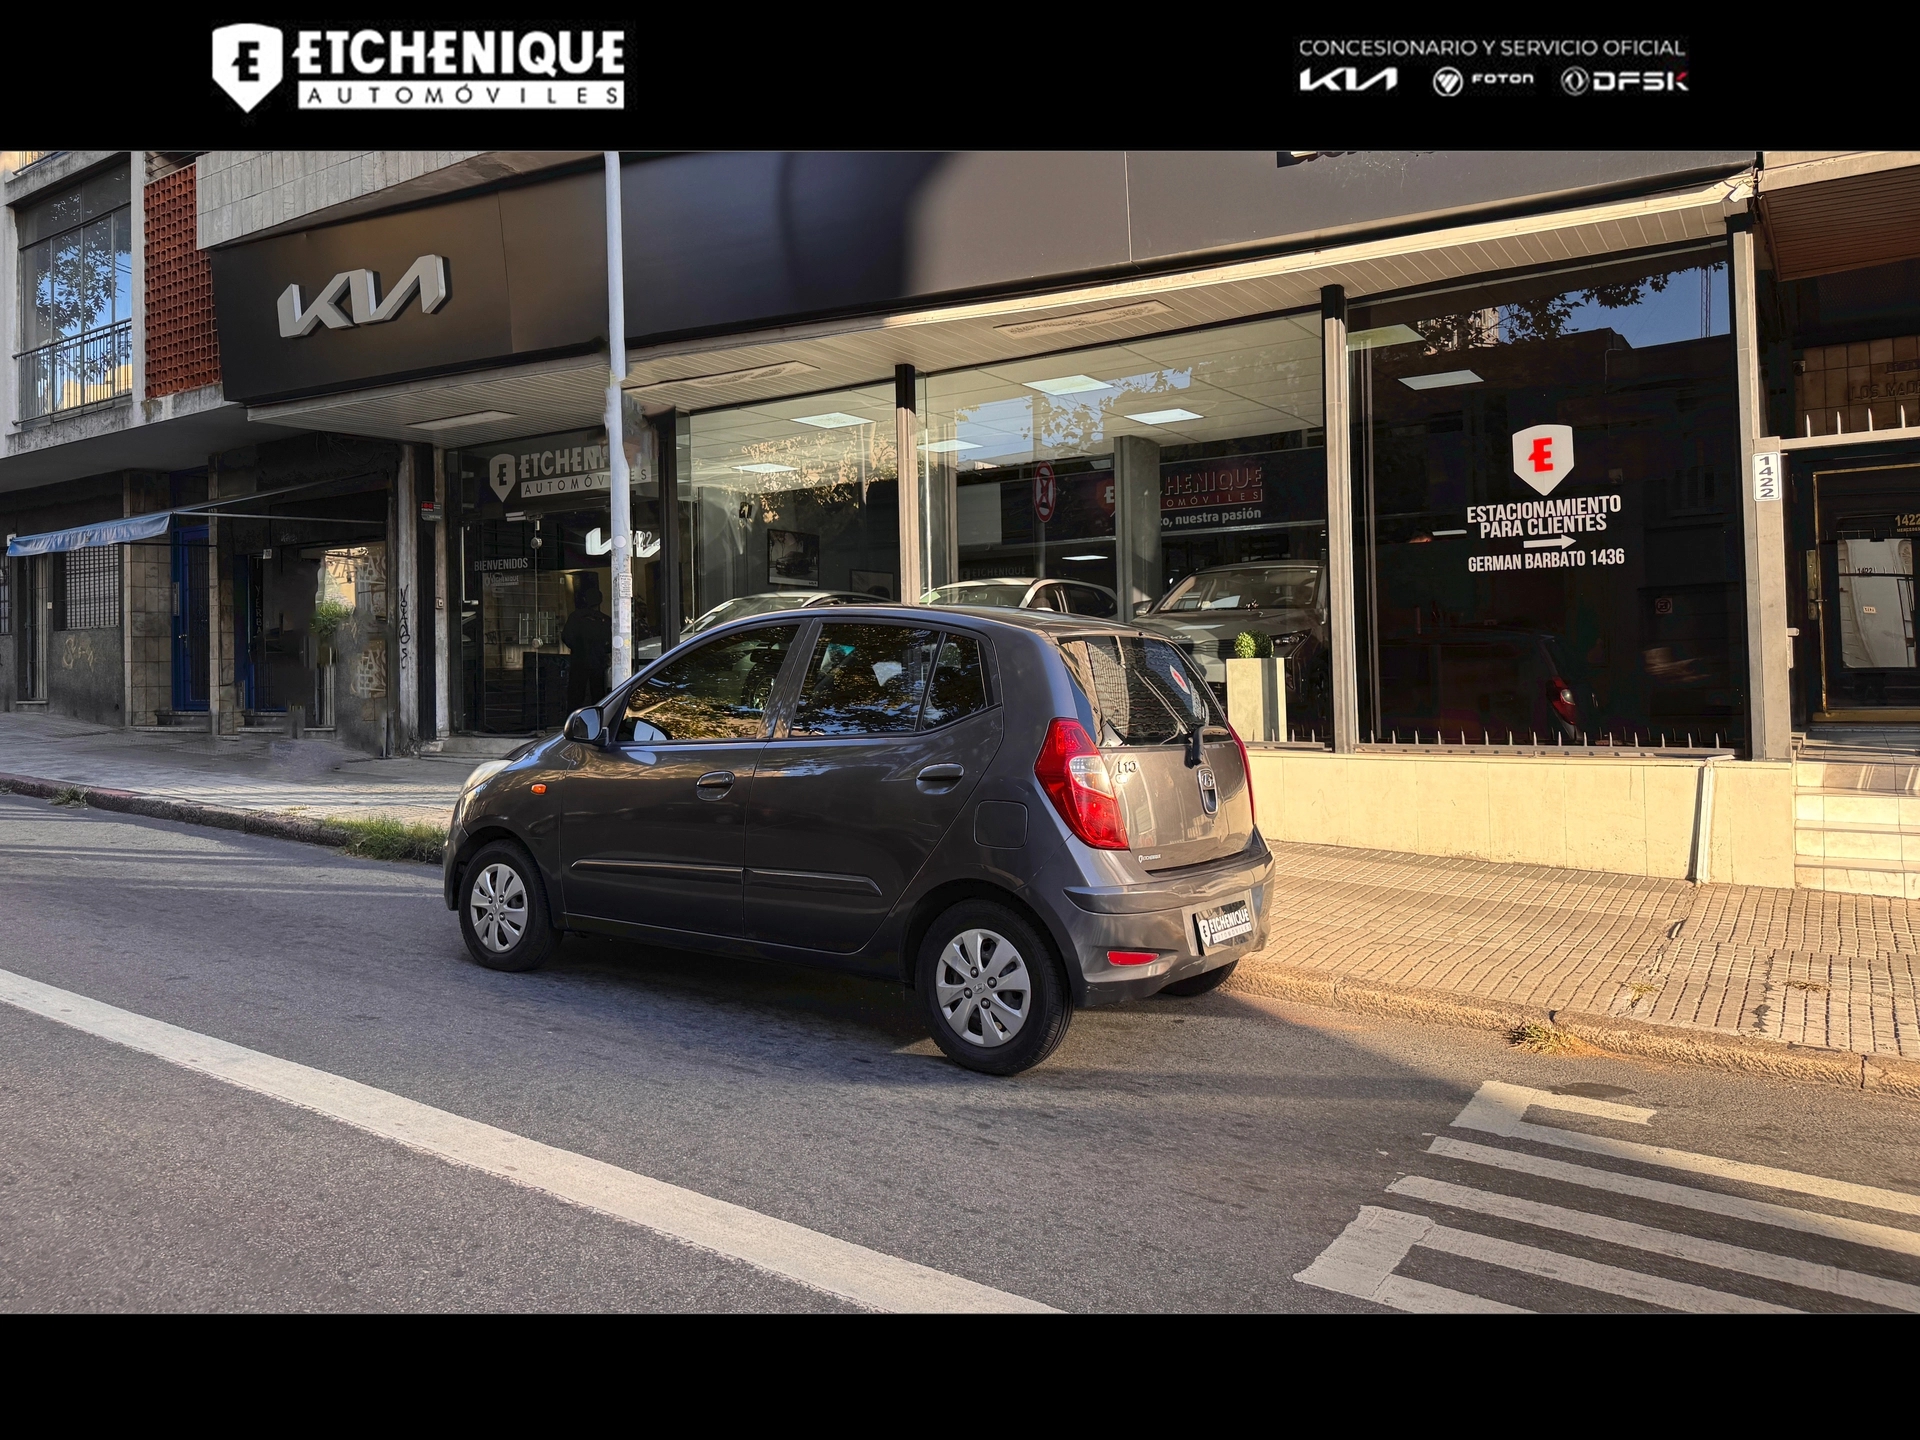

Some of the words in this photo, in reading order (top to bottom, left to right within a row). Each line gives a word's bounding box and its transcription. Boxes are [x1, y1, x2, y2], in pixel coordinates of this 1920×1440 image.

[277, 254, 449, 339] KIA
[524, 468, 647, 495] AUTOMÓVES
[1758, 456, 1775, 498] 1422
[1175, 512, 1219, 526] nuestra
[1222, 509, 1262, 524] pasión
[1467, 494, 1622, 523] ESTACIONAMIENTO
[1480, 519, 1524, 539] PARA
[1527, 513, 1607, 535] CLIENTES
[474, 557, 529, 571] BIENVENIDOS
[1468, 554, 1522, 572] GERMAN
[1525, 550, 1586, 569] BARBATO
[1590, 548, 1625, 566] 1436
